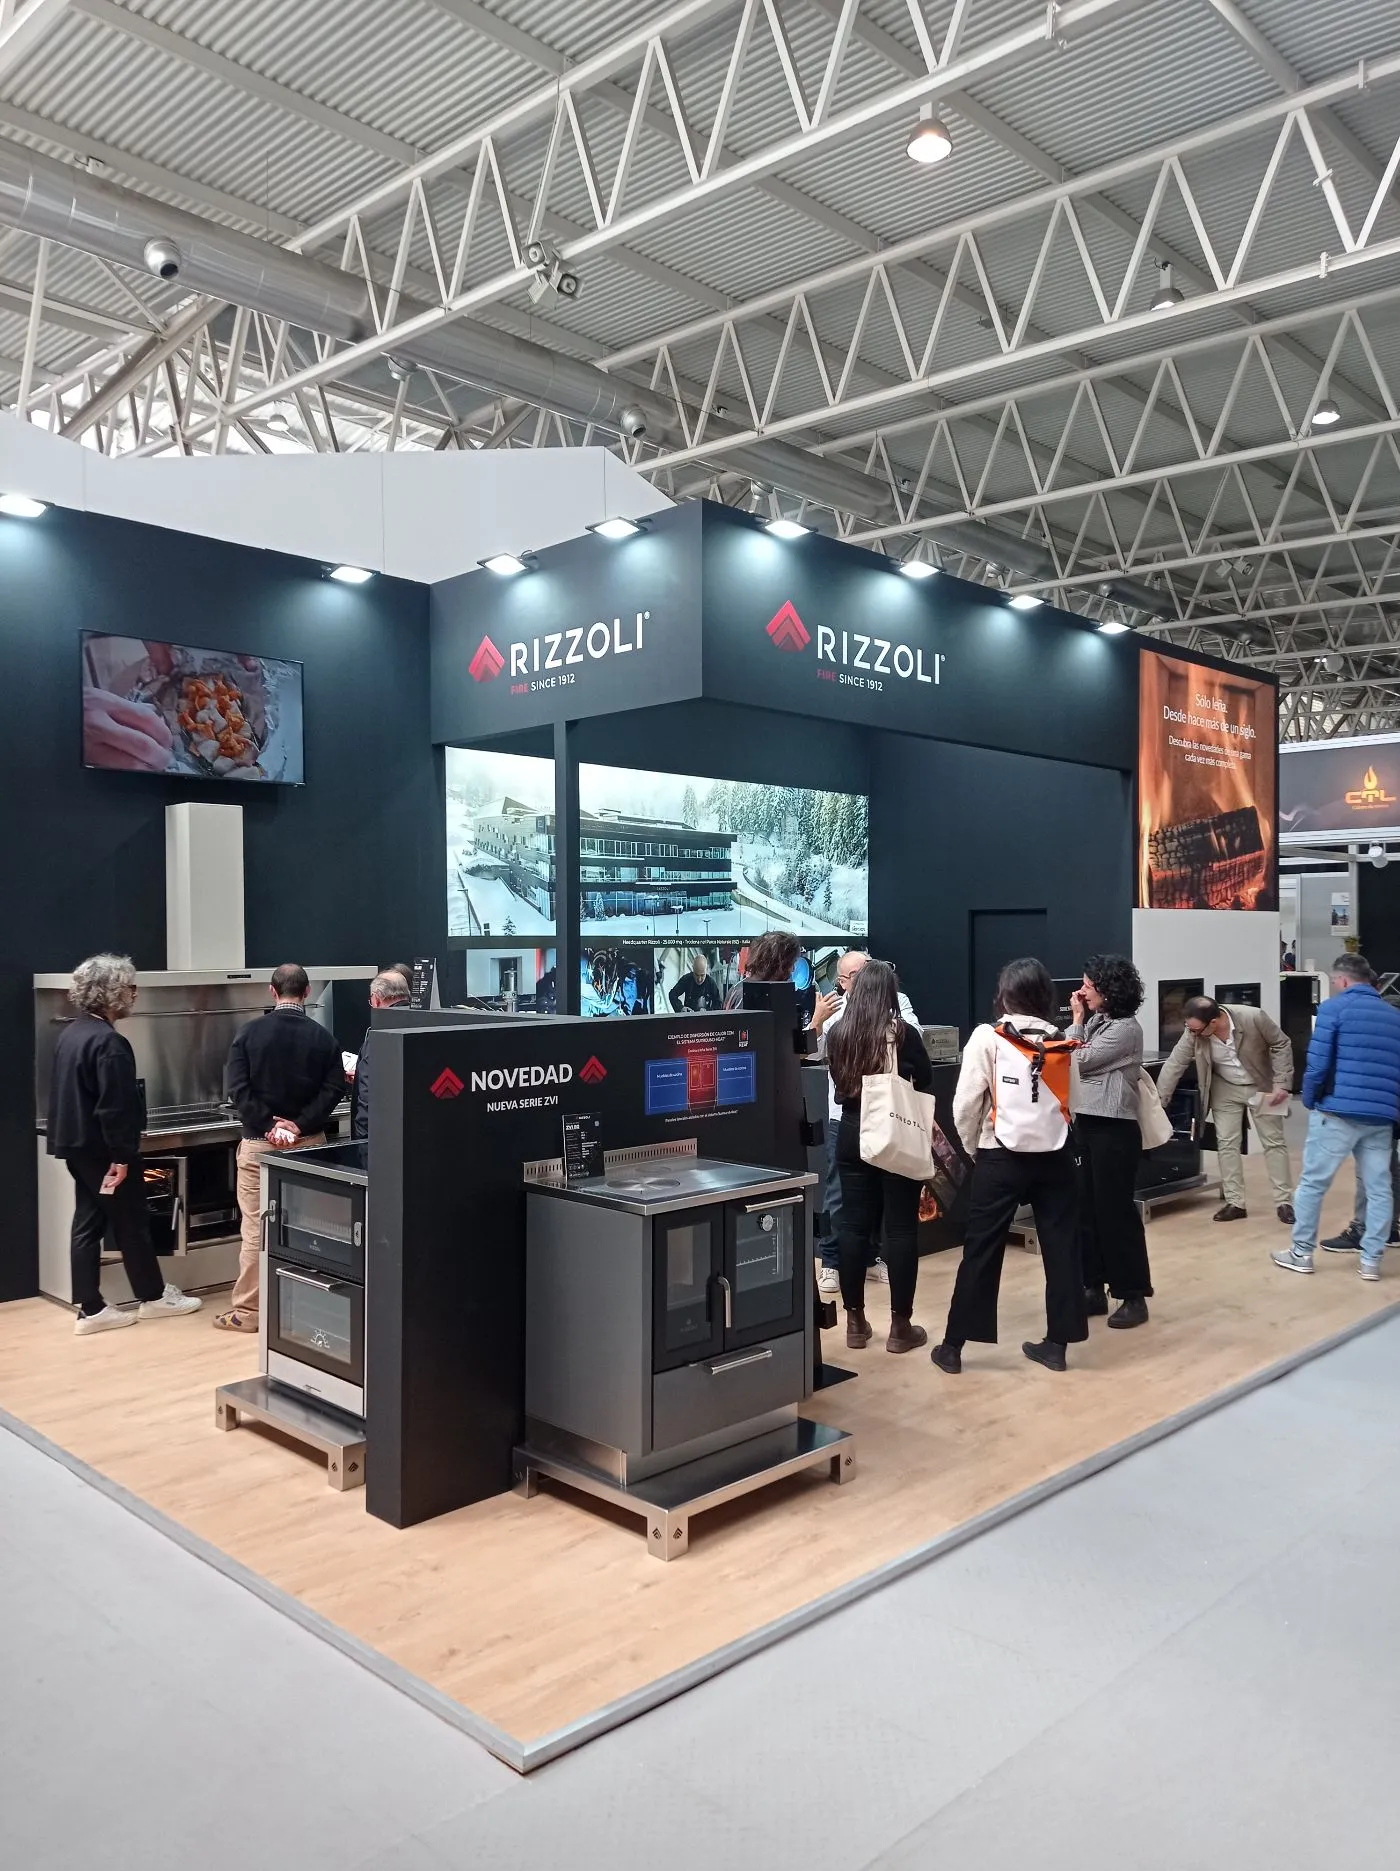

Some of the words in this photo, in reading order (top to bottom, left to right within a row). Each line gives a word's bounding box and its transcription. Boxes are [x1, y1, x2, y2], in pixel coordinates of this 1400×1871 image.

[511, 683, 529, 695] FIRE
[531, 677, 556, 691] SINCE
[558, 673, 576, 687] 1912
[817, 669, 837, 682] FIRE
[839, 673, 865, 687] SINCE
[866, 679, 883, 692] 1912
[1195, 694, 1211, 709] Sólo
[1212, 696, 1228, 713] leña.
[1163, 705, 1186, 724] Desde
[1187, 711, 1205, 727] hace
[1205, 717, 1219, 731] más
[1220, 719, 1229, 733] de
[1230, 723, 1239, 735] un
[1239, 723, 1256, 740] siglo.
[1168, 735, 1191, 749] Descubra
[1192, 740, 1200, 750] las
[1200, 742, 1224, 755] novedades
[1240, 751, 1252, 760] gama
[1185, 753, 1196, 763] cada
[1197, 756, 1205, 764] vez
[1205, 756, 1216, 766] más
[471, 1063, 573, 1092] NOVEDAD
[487, 1100, 519, 1113] NUEVA
[519, 1097, 543, 1109] SERIE
[543, 1095, 558, 1106] ZVI
